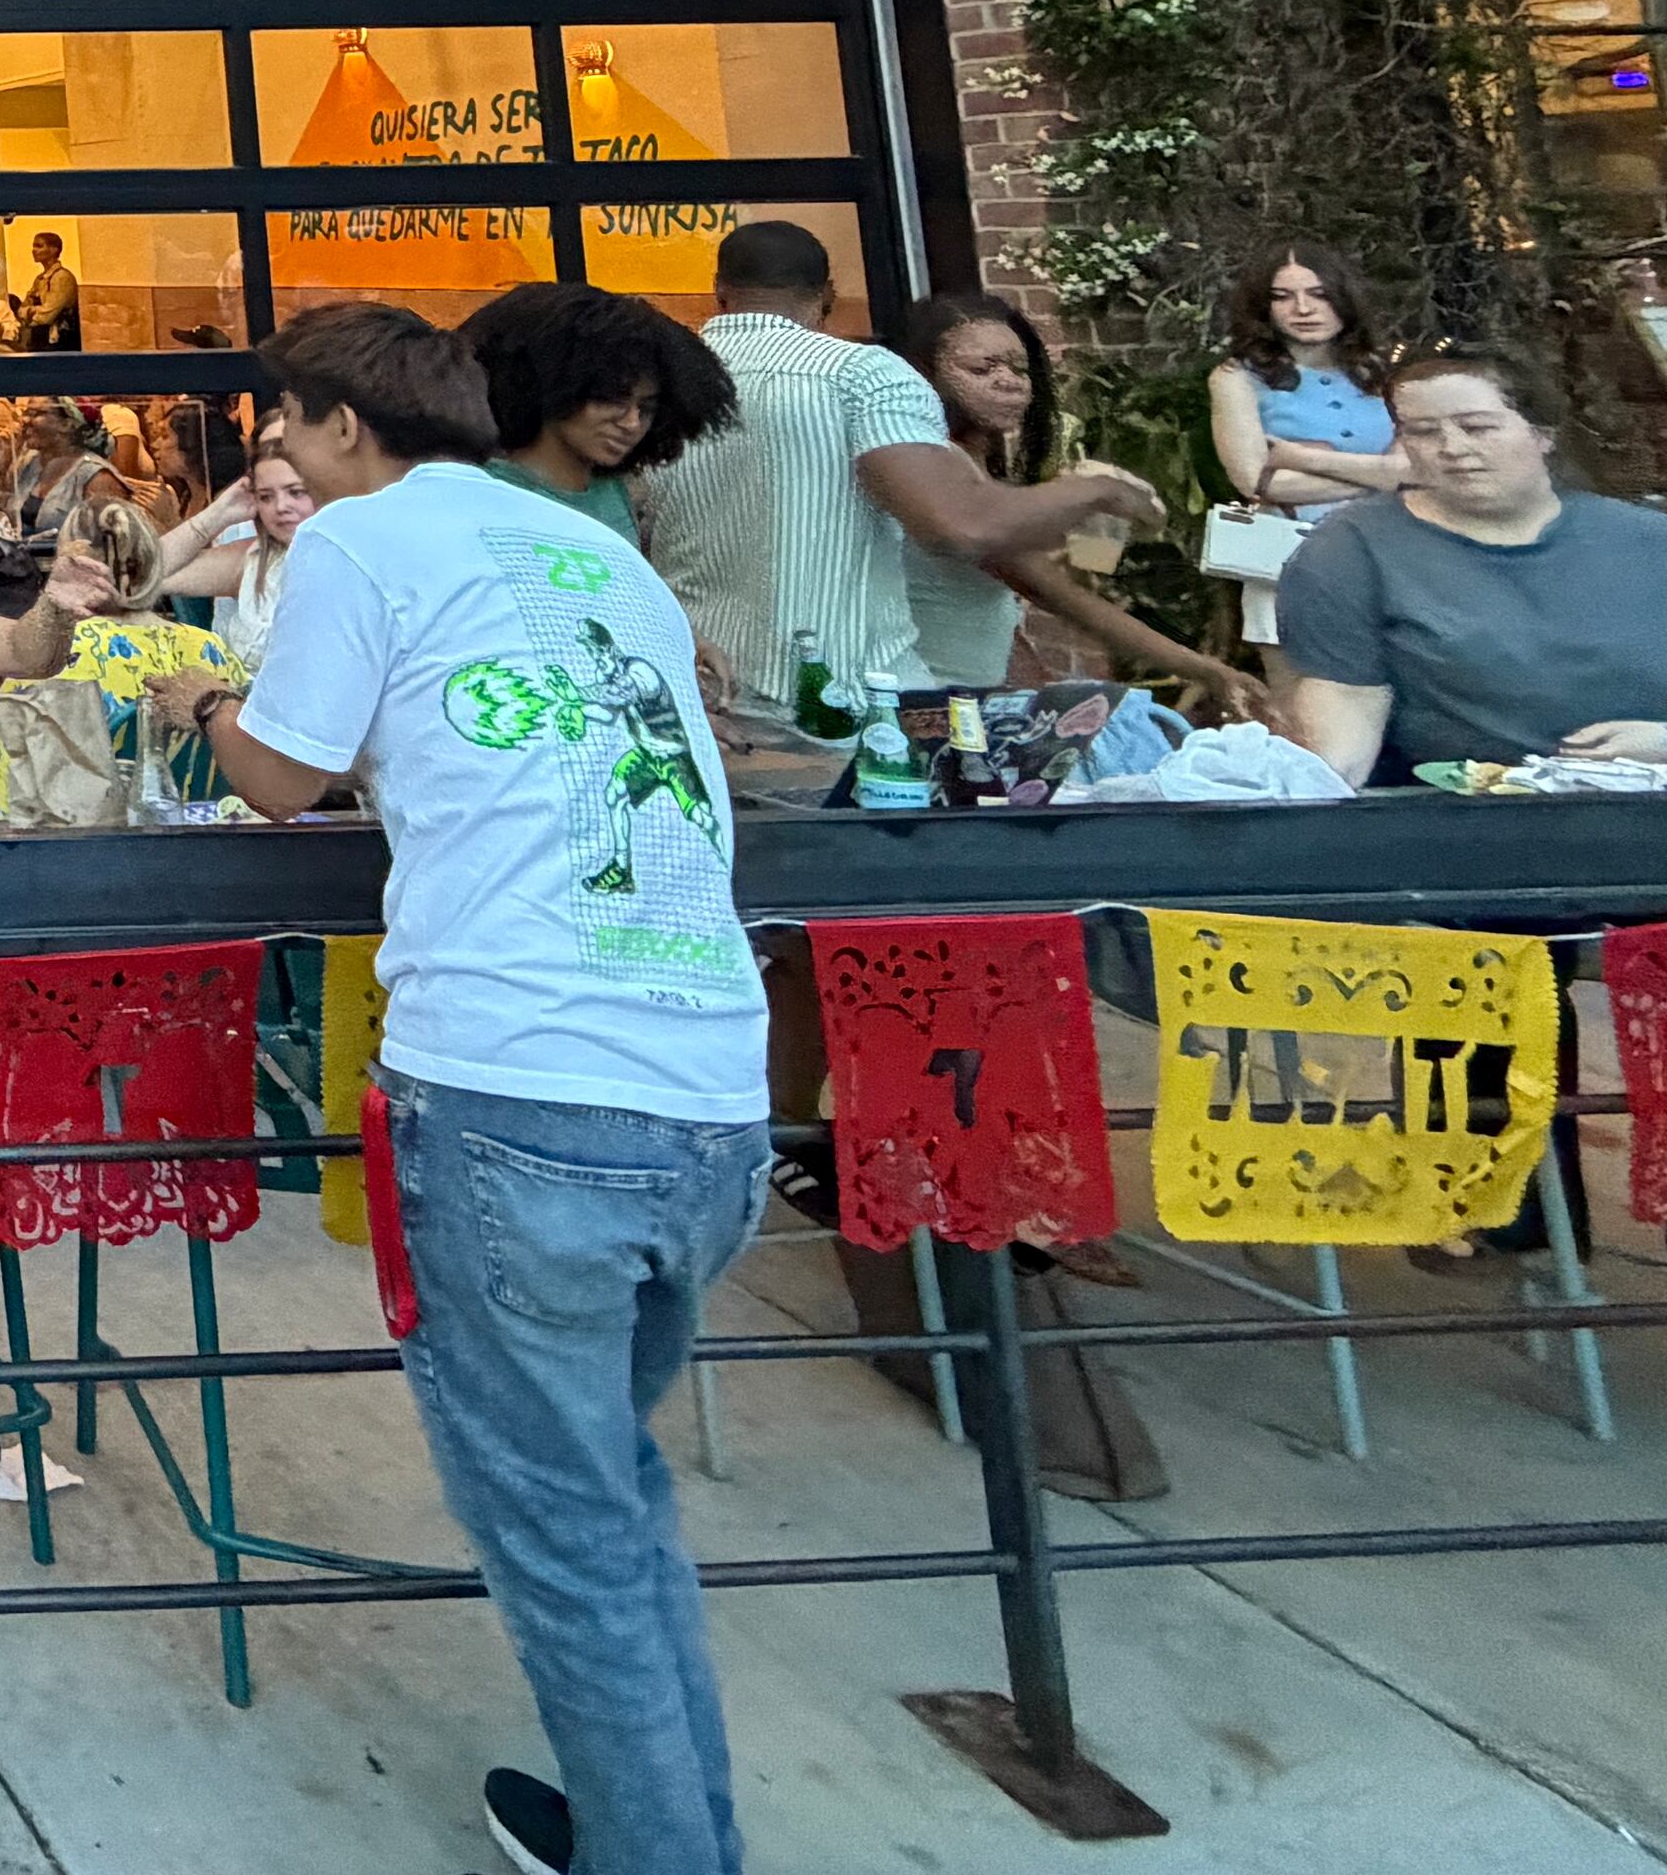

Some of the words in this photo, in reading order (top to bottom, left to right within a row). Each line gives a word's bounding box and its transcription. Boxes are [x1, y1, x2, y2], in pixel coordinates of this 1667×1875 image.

[370, 97, 477, 146] QUISIERA
[490, 88, 544, 134] SER
[289, 209, 339, 243] PARA
[347, 207, 470, 241] QUEDARME
[486, 206, 524, 241] EN
